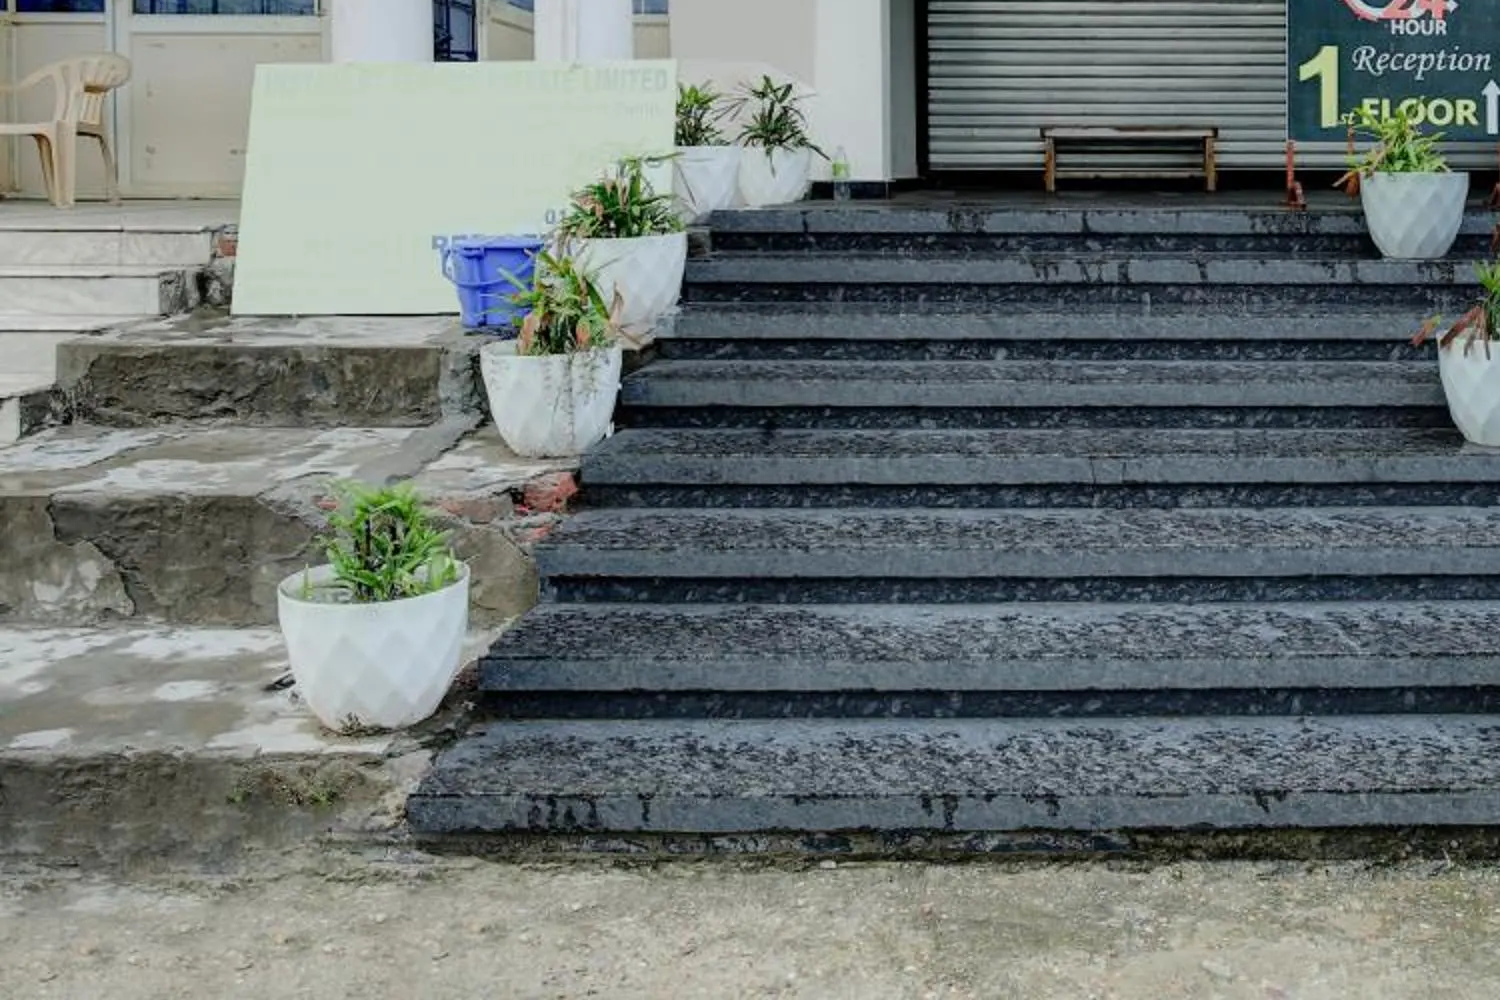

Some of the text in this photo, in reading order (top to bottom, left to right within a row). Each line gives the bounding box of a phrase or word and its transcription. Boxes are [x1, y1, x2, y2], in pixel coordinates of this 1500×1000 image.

[1390, 19, 1447, 36] HOUR
[1352, 45, 1491, 80] Reception
[1362, 97, 1479, 126] FLOOR
